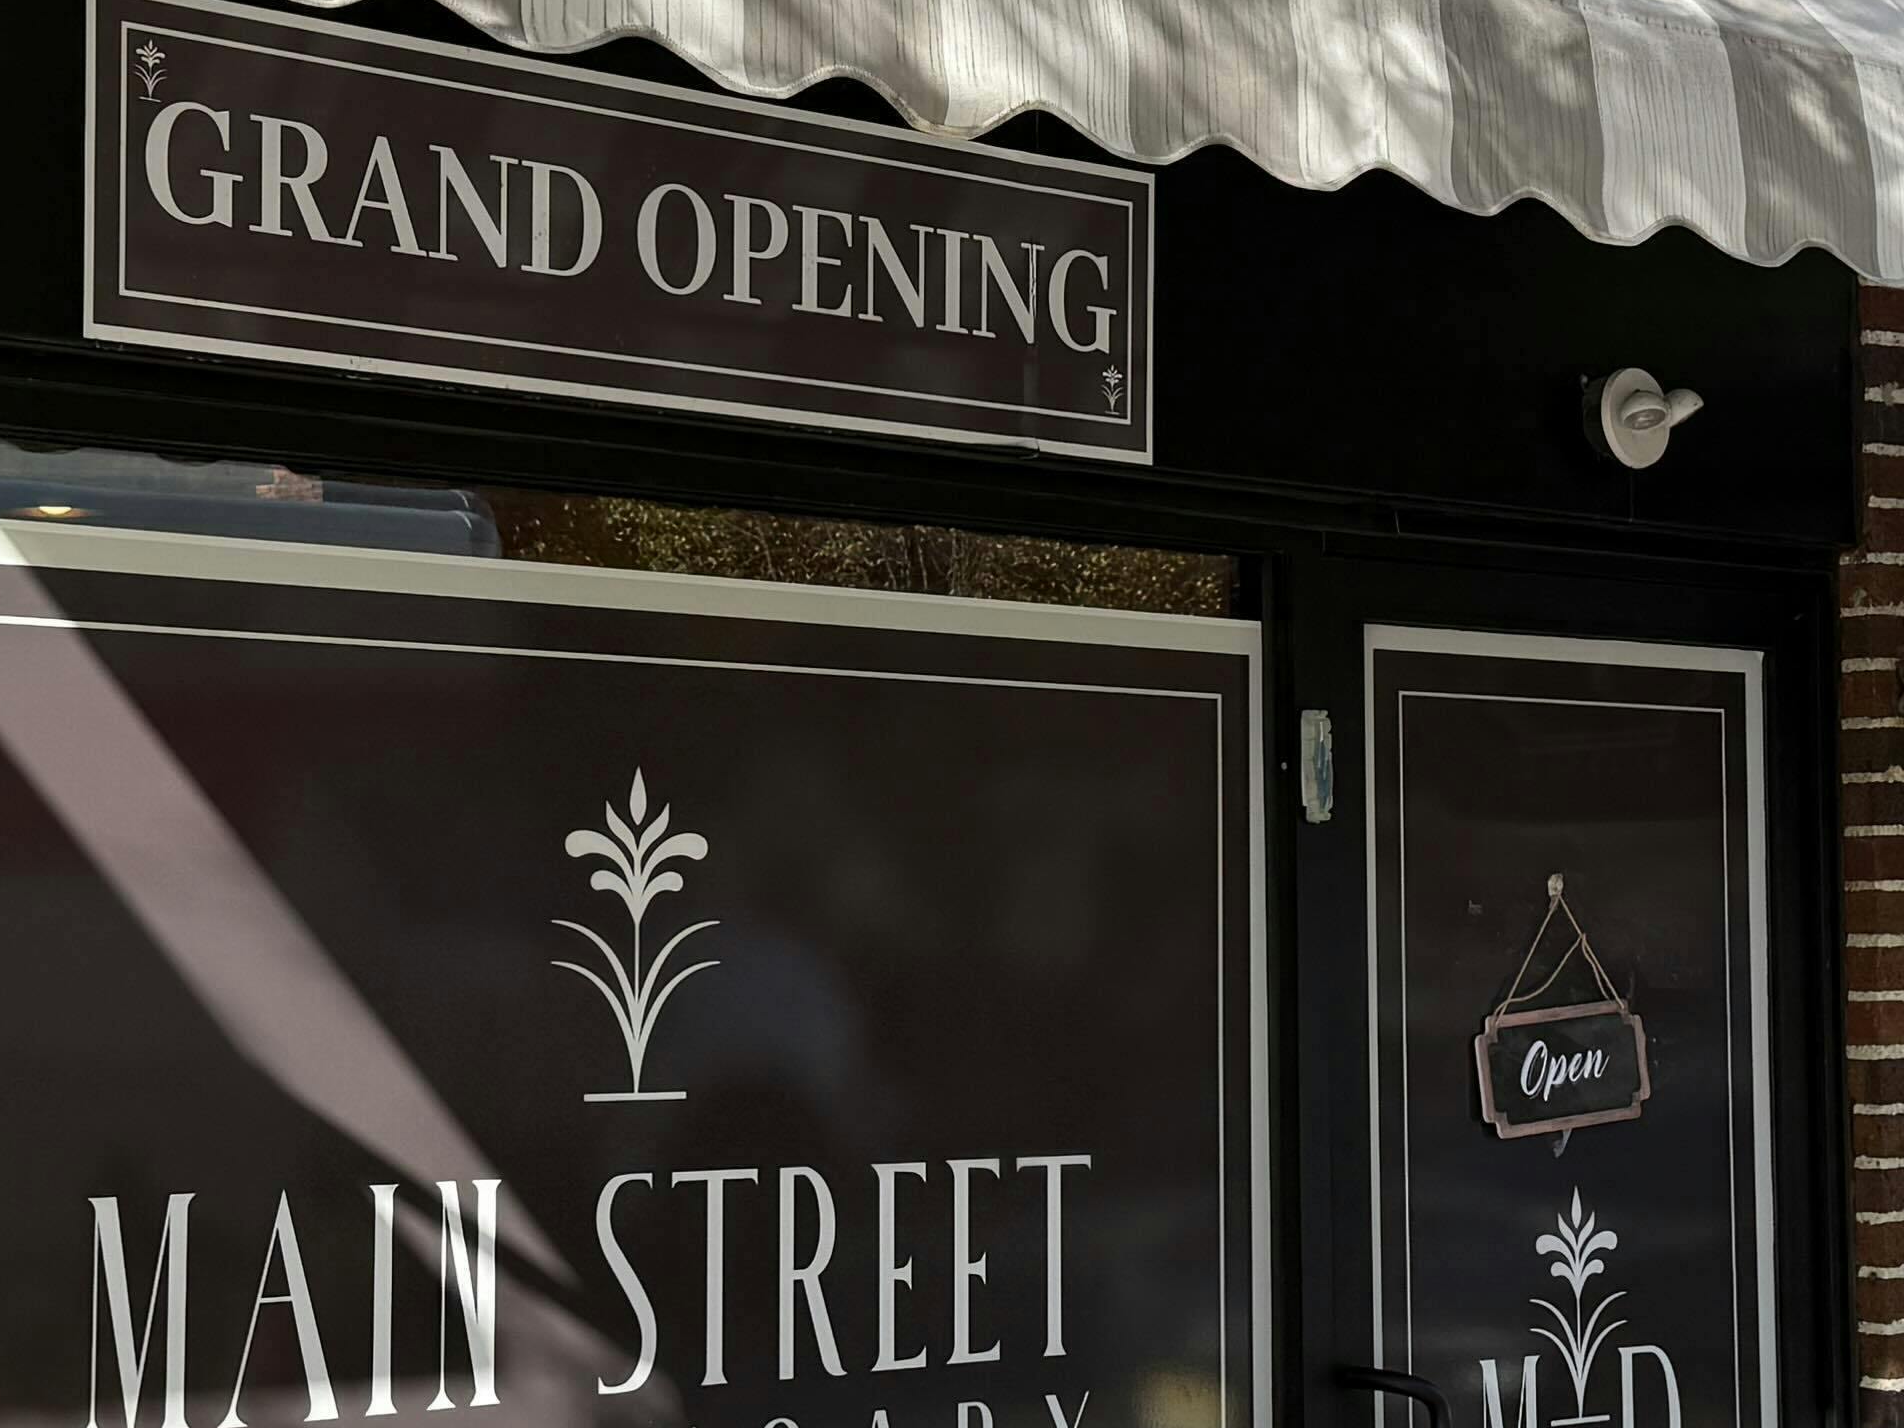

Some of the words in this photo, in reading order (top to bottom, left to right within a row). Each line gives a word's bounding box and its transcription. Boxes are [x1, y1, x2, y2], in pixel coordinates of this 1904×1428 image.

[142, 100, 603, 278] GRAND
[636, 182, 1118, 355] OPENING
[1519, 1038, 1609, 1102] Open
[595, 1154, 1092, 1395] STREET
